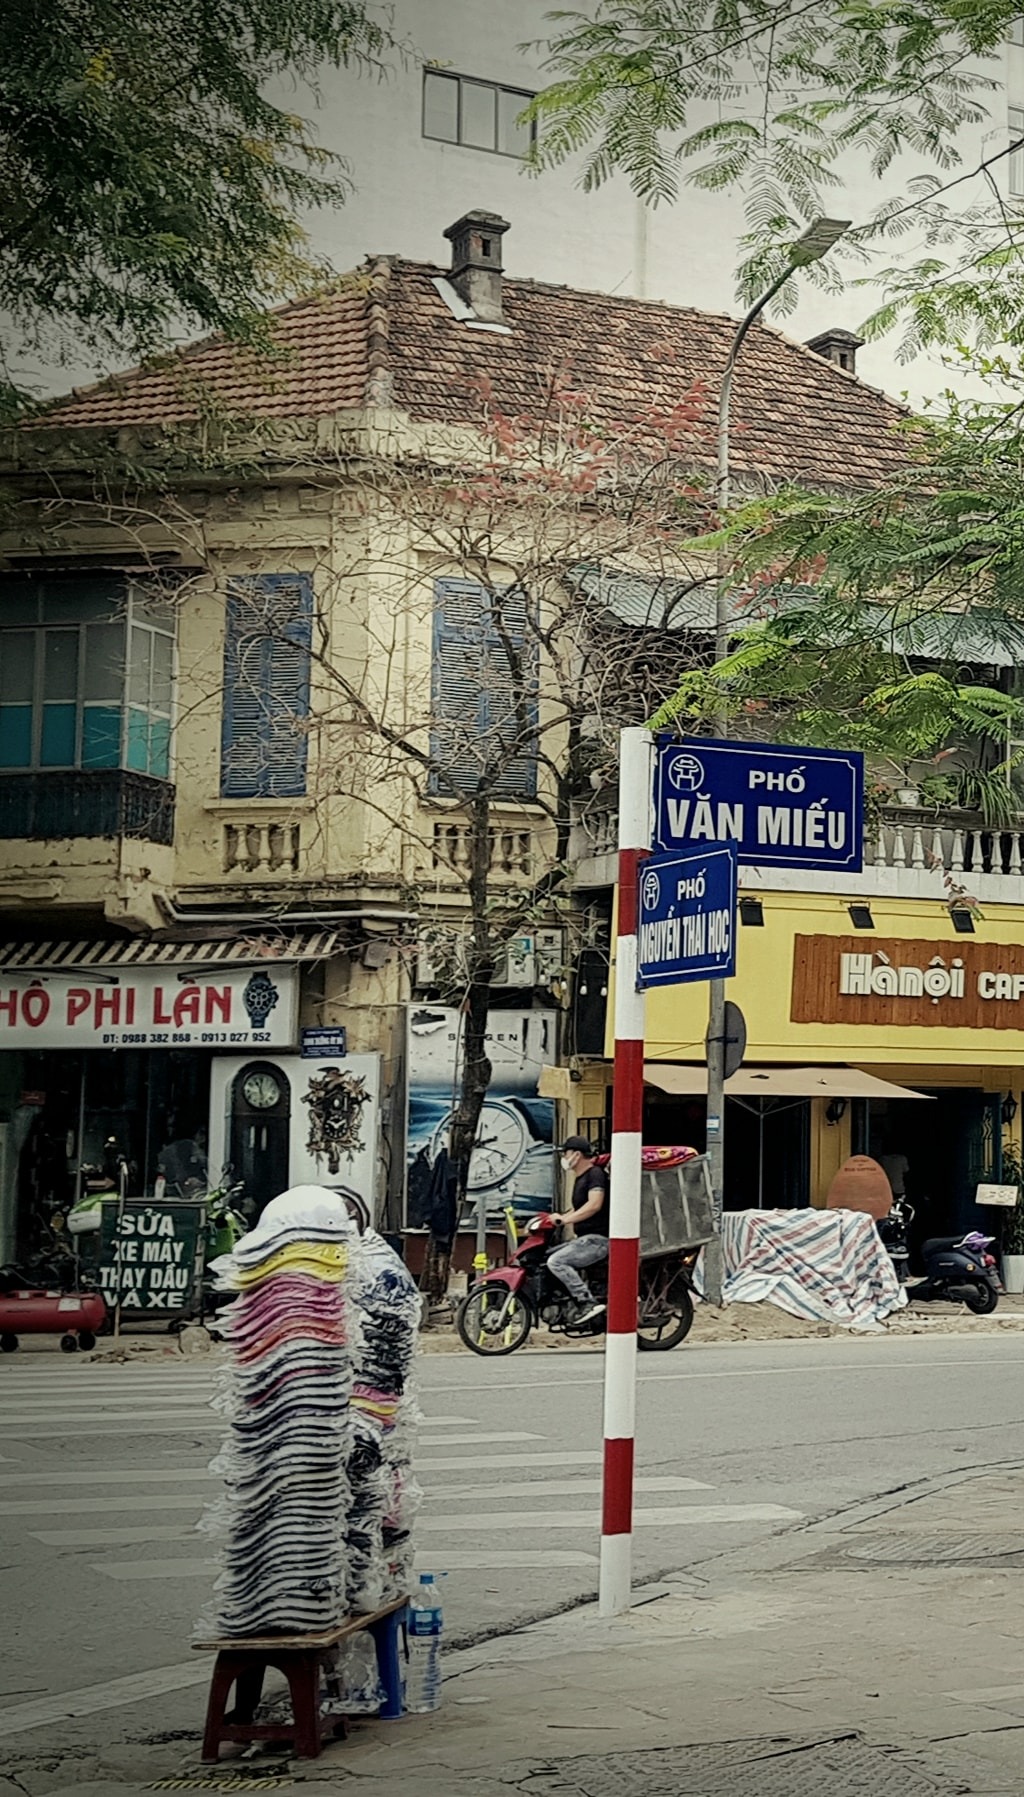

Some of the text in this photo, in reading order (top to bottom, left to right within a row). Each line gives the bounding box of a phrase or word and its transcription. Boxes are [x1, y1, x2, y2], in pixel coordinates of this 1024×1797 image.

[749, 766, 806, 793] PHỐ
[666, 792, 846, 850] VĂN MIẾU
[677, 867, 707, 901] PHỐ
[682, 904, 706, 958] THÁI
[708, 908, 731, 962] HỌC
[66, 987, 135, 1030] PHI
[201, 1033, 227, 1042] 0913
[230, 1033, 249, 1042] 027
[252, 1032, 271, 1042] 952
[448, 1033, 518, 1041] SGEN
[116, 1208, 175, 1237] SỬA
[110, 1238, 185, 1262] XE MÁY
[99, 1266, 147, 1289] THAY
[103, 1288, 184, 1308] VÁ XE
